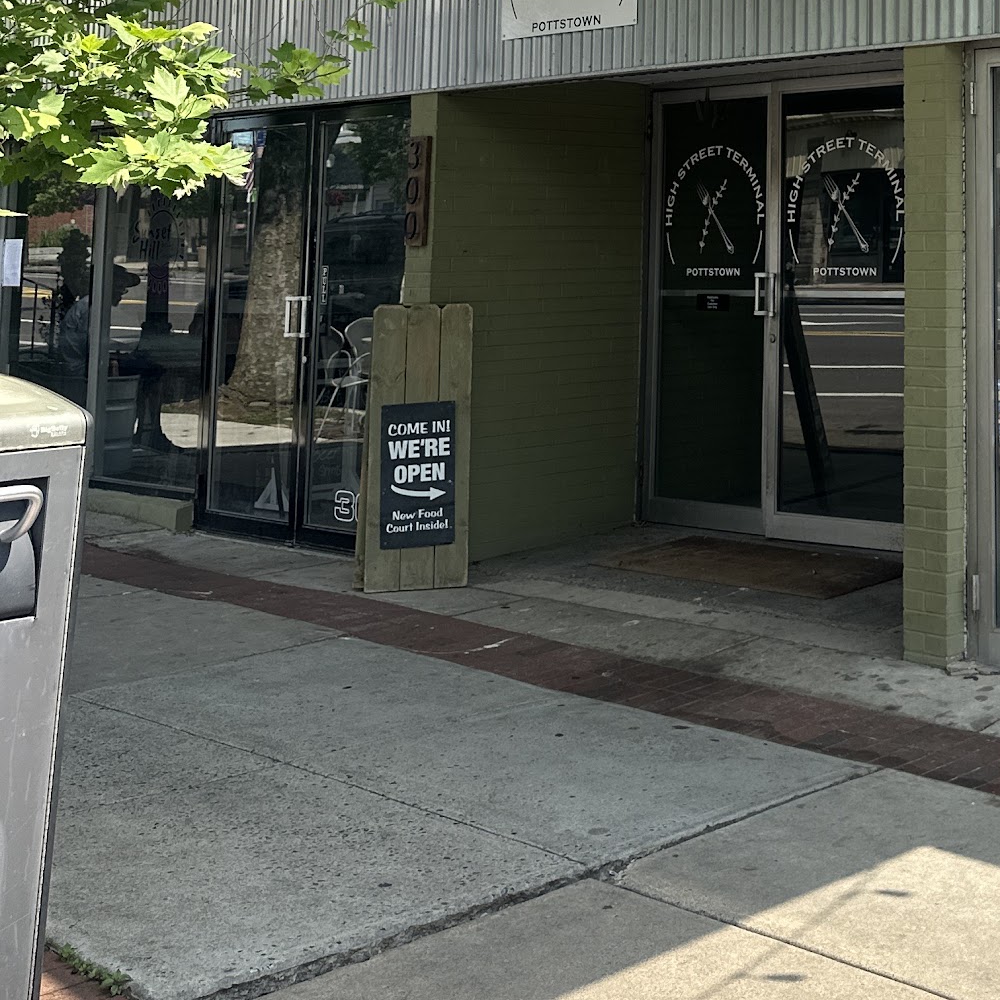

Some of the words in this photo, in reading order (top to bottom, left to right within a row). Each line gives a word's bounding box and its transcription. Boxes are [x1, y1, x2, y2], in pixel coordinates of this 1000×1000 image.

[531, 14, 601, 33] POTTSTOWN
[665, 182, 680, 227] HIGH
[677, 145, 724, 180] STREET
[725, 147, 765, 225] TERMINAL
[787, 174, 803, 223] HIGH
[801, 136, 855, 173] STREET
[858, 138, 905, 221] TERMINAL
[405, 141, 421, 240] 300
[686, 267, 741, 277] POTTSTOWN
[812, 267, 877, 277] POTTSTOWN
[387, 421, 429, 437] COME
[432, 419, 451, 433] IN!
[388, 437, 451, 460] WE'RE
[394, 462, 446, 484] OPEN
[392, 510, 416, 521] New
[418, 507, 443, 519] Food
[386, 522, 413, 534] Court
[415, 519, 449, 531] Inside!
